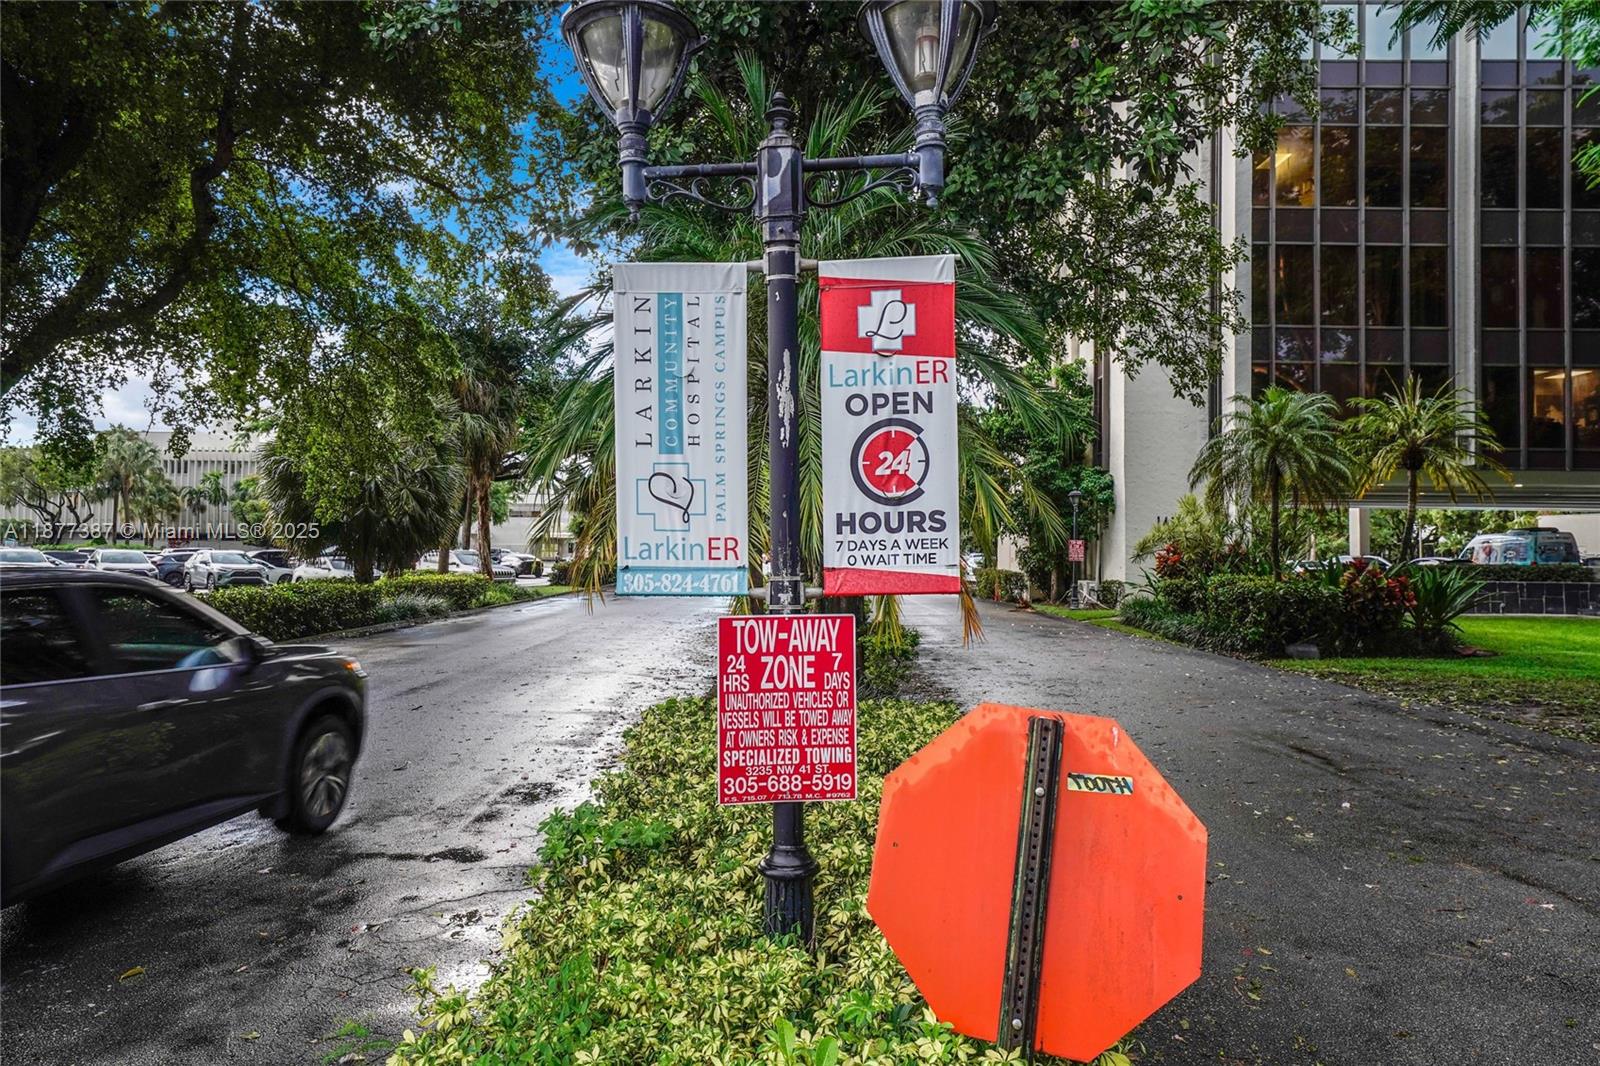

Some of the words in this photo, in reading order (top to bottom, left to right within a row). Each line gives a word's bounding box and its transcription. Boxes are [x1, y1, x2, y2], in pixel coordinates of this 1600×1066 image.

[715, 295, 726, 372] CAMPUS
[634, 296, 652, 448] LARKIN
[664, 298, 678, 447] COMMUNITY
[687, 296, 700, 447] HOSPITAL
[829, 360, 949, 387] LarkinER
[845, 391, 933, 416] OPEN
[715, 381, 726, 463] SPRINGS
[874, 449, 911, 476] 24
[715, 473, 726, 522] PALM
[836, 510, 947, 534] HOURS
[624, 536, 740, 561] LarkinER
[836, 541, 844, 552] 7
[848, 540, 887, 551] DAYS
[891, 539, 902, 550] A
[905, 538, 949, 549] WEEK
[861, 554, 900, 566] WAIT
[903, 553, 937, 564] TIME
[623, 574, 739, 593] 305-824-4761
[732, 619, 841, 654] TOW-AWAY
[727, 655, 746, 673] 24
[760, 655, 816, 689] ZONE
[832, 653, 842, 671] 7
[723, 674, 750, 692] HRS
[824, 672, 850, 690] DAYS
[725, 692, 789, 710] UNAUTHORIZED
[793, 692, 833, 707] VEHICLES
[836, 691, 849, 707] OR
[721, 711, 760, 729] VESSELS
[762, 710, 782, 728] WILL
[785, 710, 796, 727] BE
[799, 709, 829, 727] TOWED
[831, 709, 853, 726] AWAY
[725, 731, 736, 748] AT
[738, 730, 776, 747] OWNERS
[778, 729, 798, 746] RISK
[801, 729, 808, 745] &
[811, 728, 849, 745] EXPENSE
[723, 748, 800, 767] SPECIALIZED
[805, 747, 852, 763] TOWING
[745, 767, 773, 776] 3235
[776, 766, 795, 774] NW
[799, 765, 811, 774] 41
[724, 774, 852, 794] 305-688-5919
[1067, 772, 1133, 794] TOOTH
